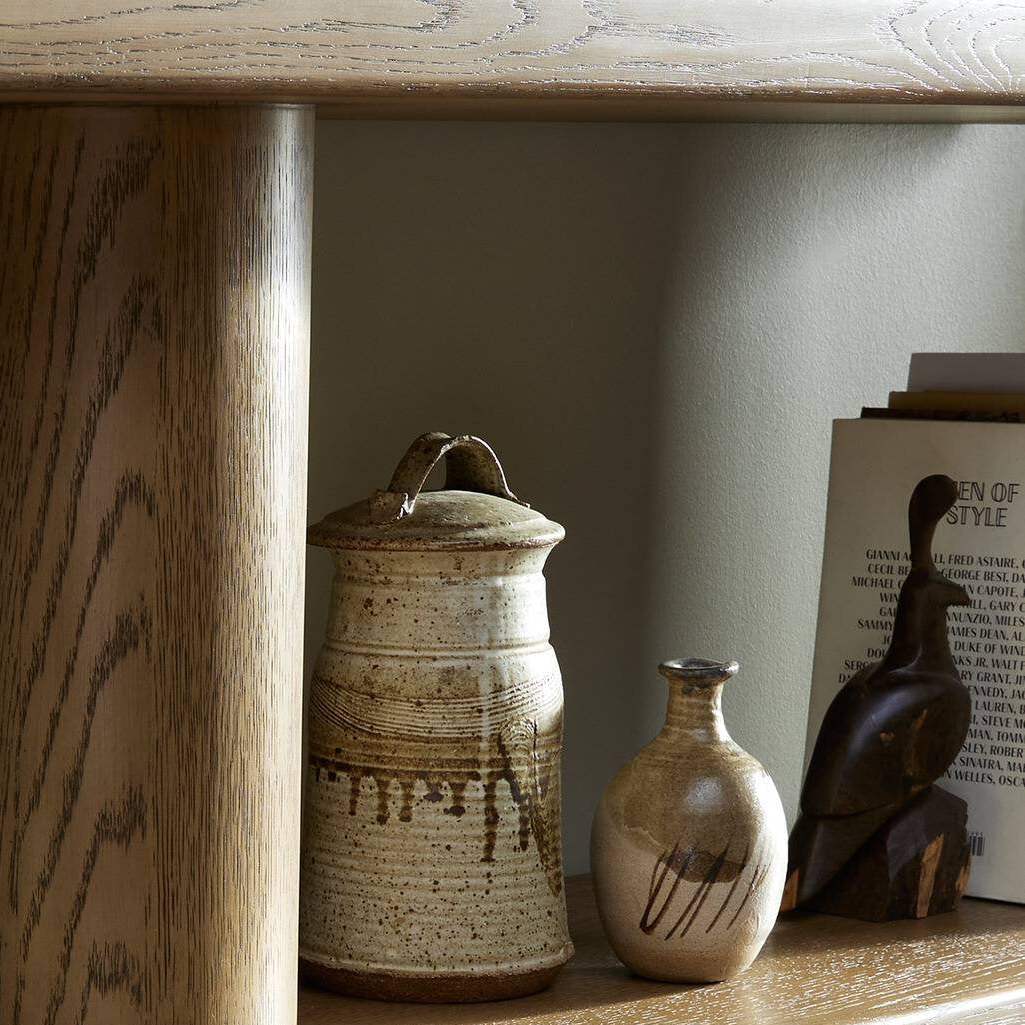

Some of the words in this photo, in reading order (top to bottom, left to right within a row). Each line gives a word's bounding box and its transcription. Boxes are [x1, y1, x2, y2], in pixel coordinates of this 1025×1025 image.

[958, 481, 985, 501] EN
[991, 483, 1020, 502] OF
[946, 505, 1007, 527] STYLE
[948, 554, 974, 566] FRED
[868, 563, 894, 575] CECIL
[942, 568, 981, 580] GEORGE
[852, 576, 894, 589] MICHAEL
[989, 600, 1017, 611] GARY
[857, 619, 893, 631] SAMMY
[995, 615, 1025, 627] MILES
[954, 641, 982, 652] DUKE
[984, 643, 997, 653] OF
[991, 658, 1017, 670] WALT
[982, 715, 1011, 728] STEVE
